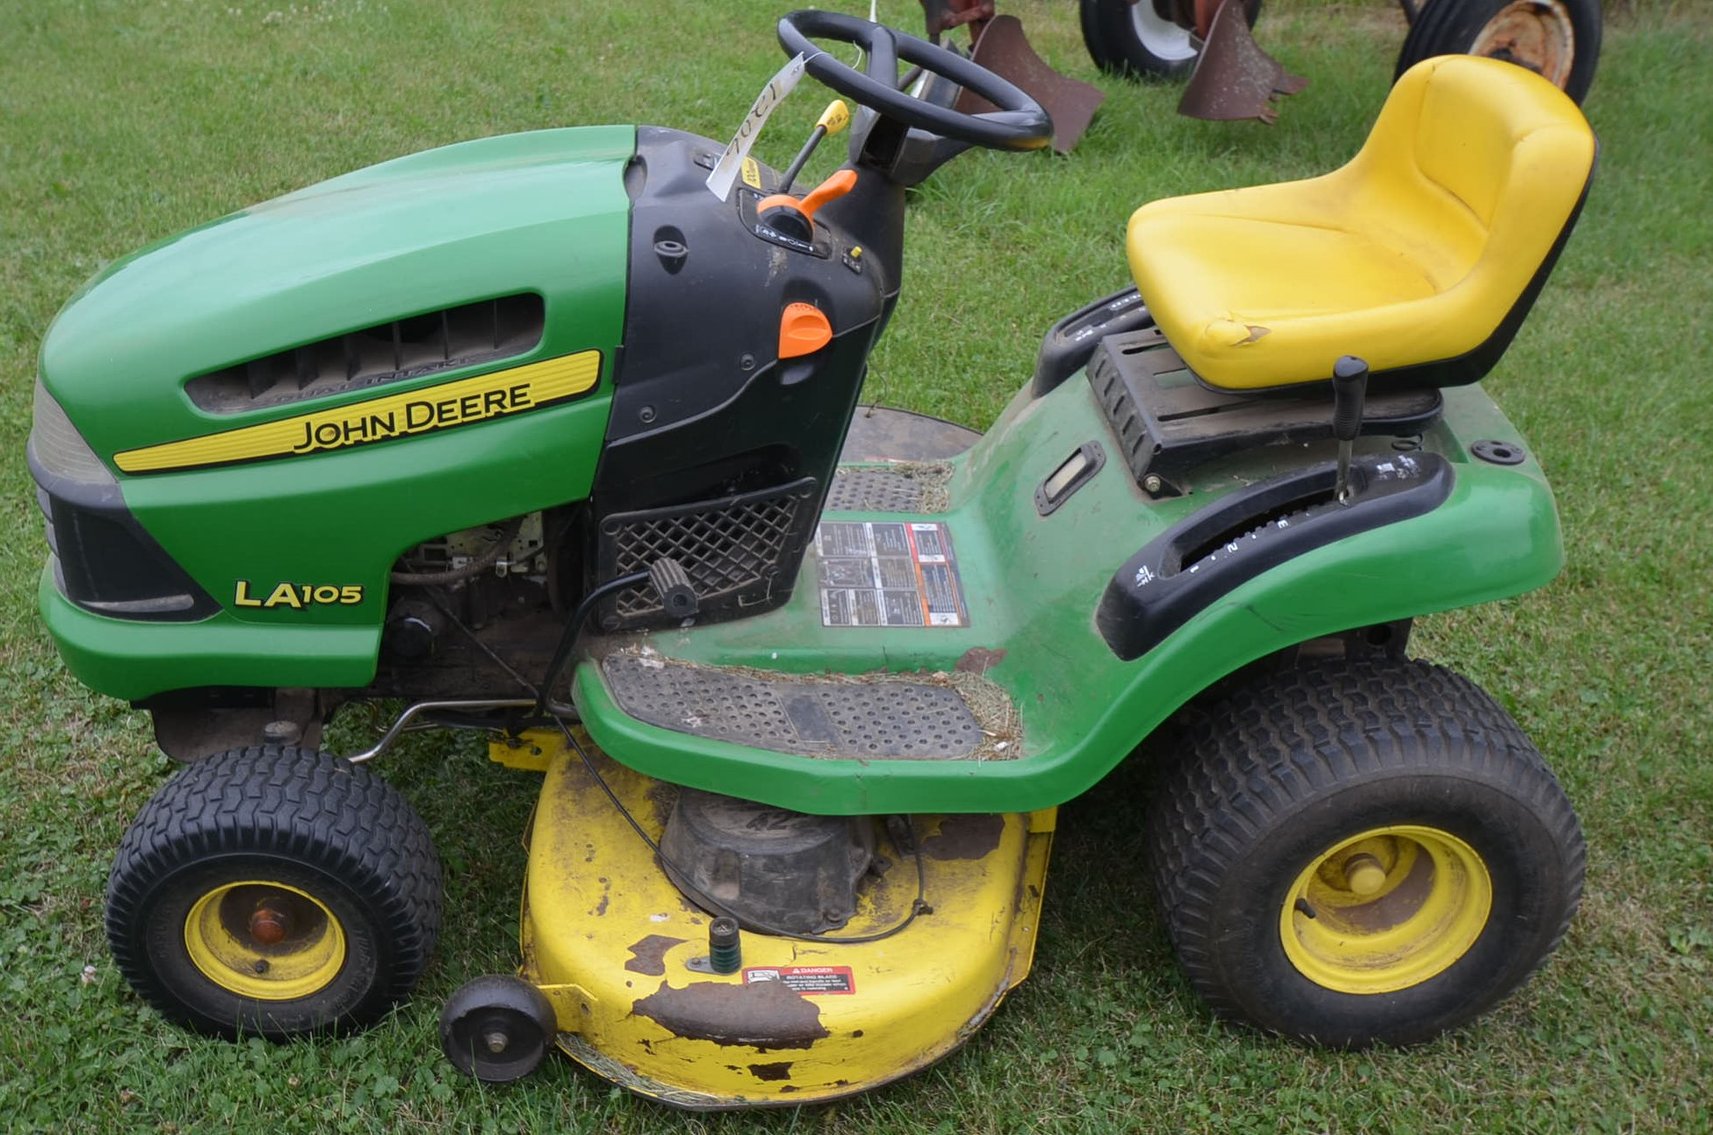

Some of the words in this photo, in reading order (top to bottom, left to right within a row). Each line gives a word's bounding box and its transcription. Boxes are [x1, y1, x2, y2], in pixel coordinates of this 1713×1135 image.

[294, 412, 395, 450] JOHN
[405, 383, 531, 430] DEERE
[235, 581, 362, 608] LA105
